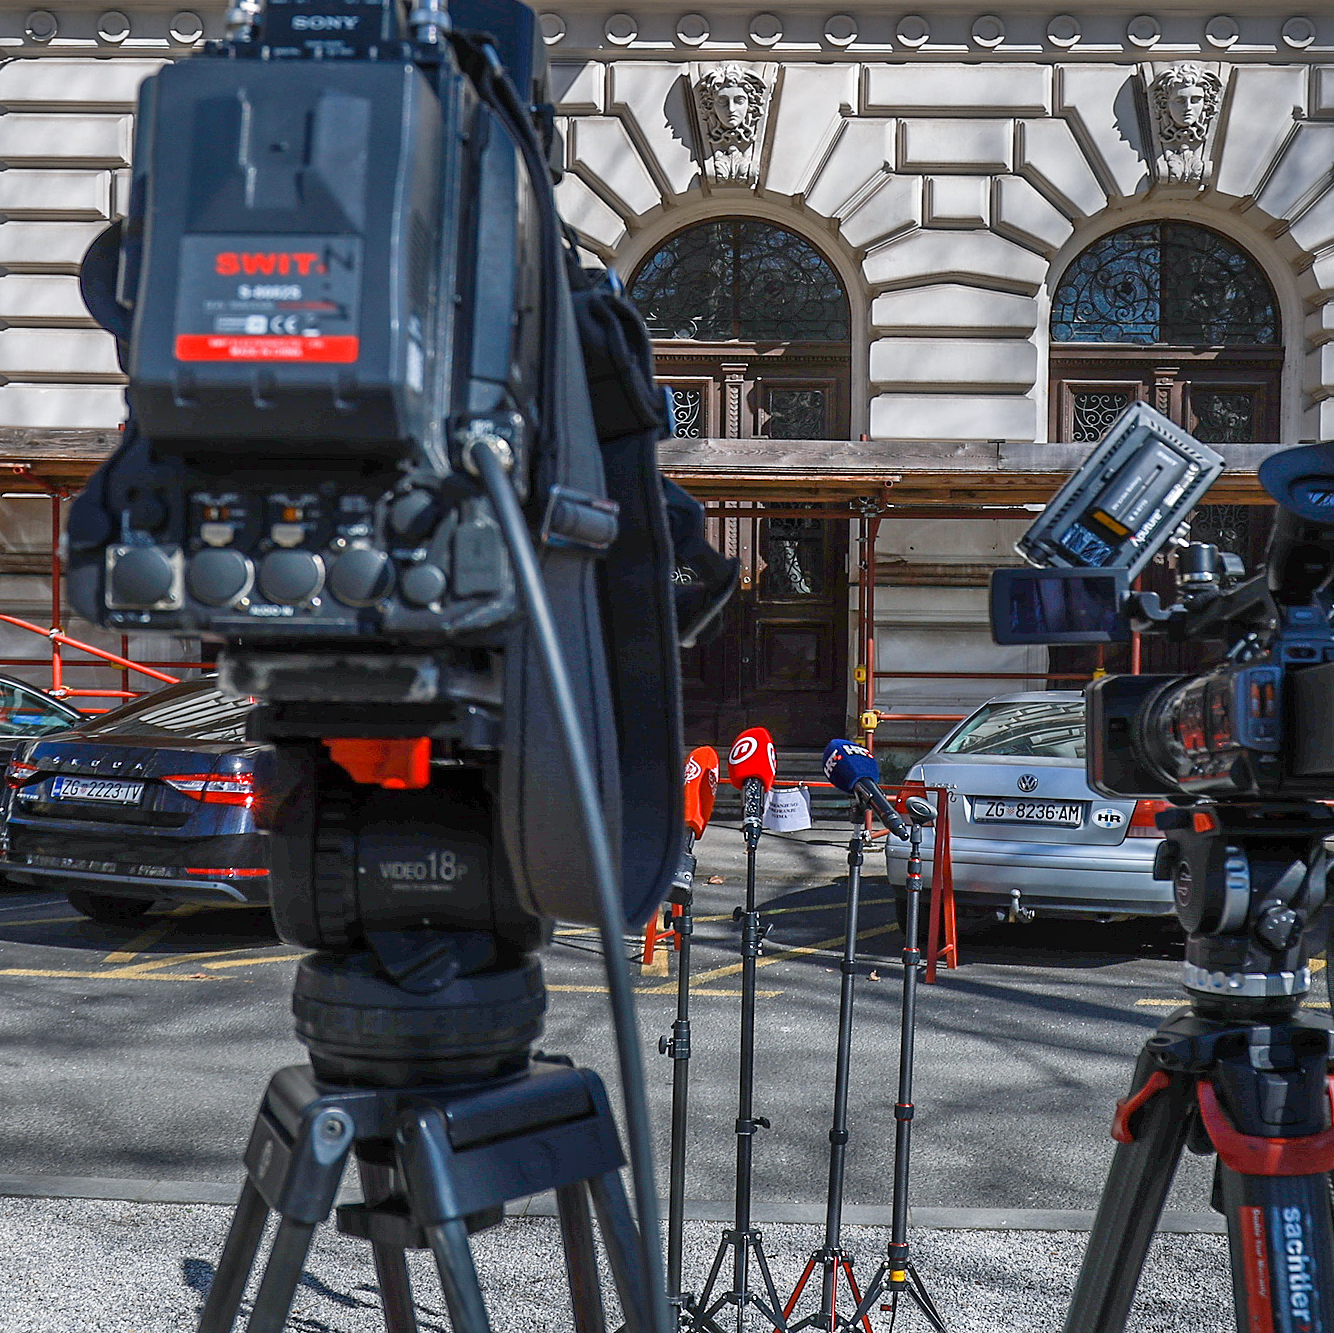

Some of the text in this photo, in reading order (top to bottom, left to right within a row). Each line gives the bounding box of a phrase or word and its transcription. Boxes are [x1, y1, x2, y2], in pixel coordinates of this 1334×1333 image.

[291, 15, 360, 30] SONY
[215, 252, 318, 276] SWIT
[1129, 508, 1163, 547] Aputure
[61, 779, 80, 796] ZG
[985, 801, 1005, 817] ZG
[1098, 813, 1121, 823] HR
[1283, 1207, 1313, 1322] sachtler
